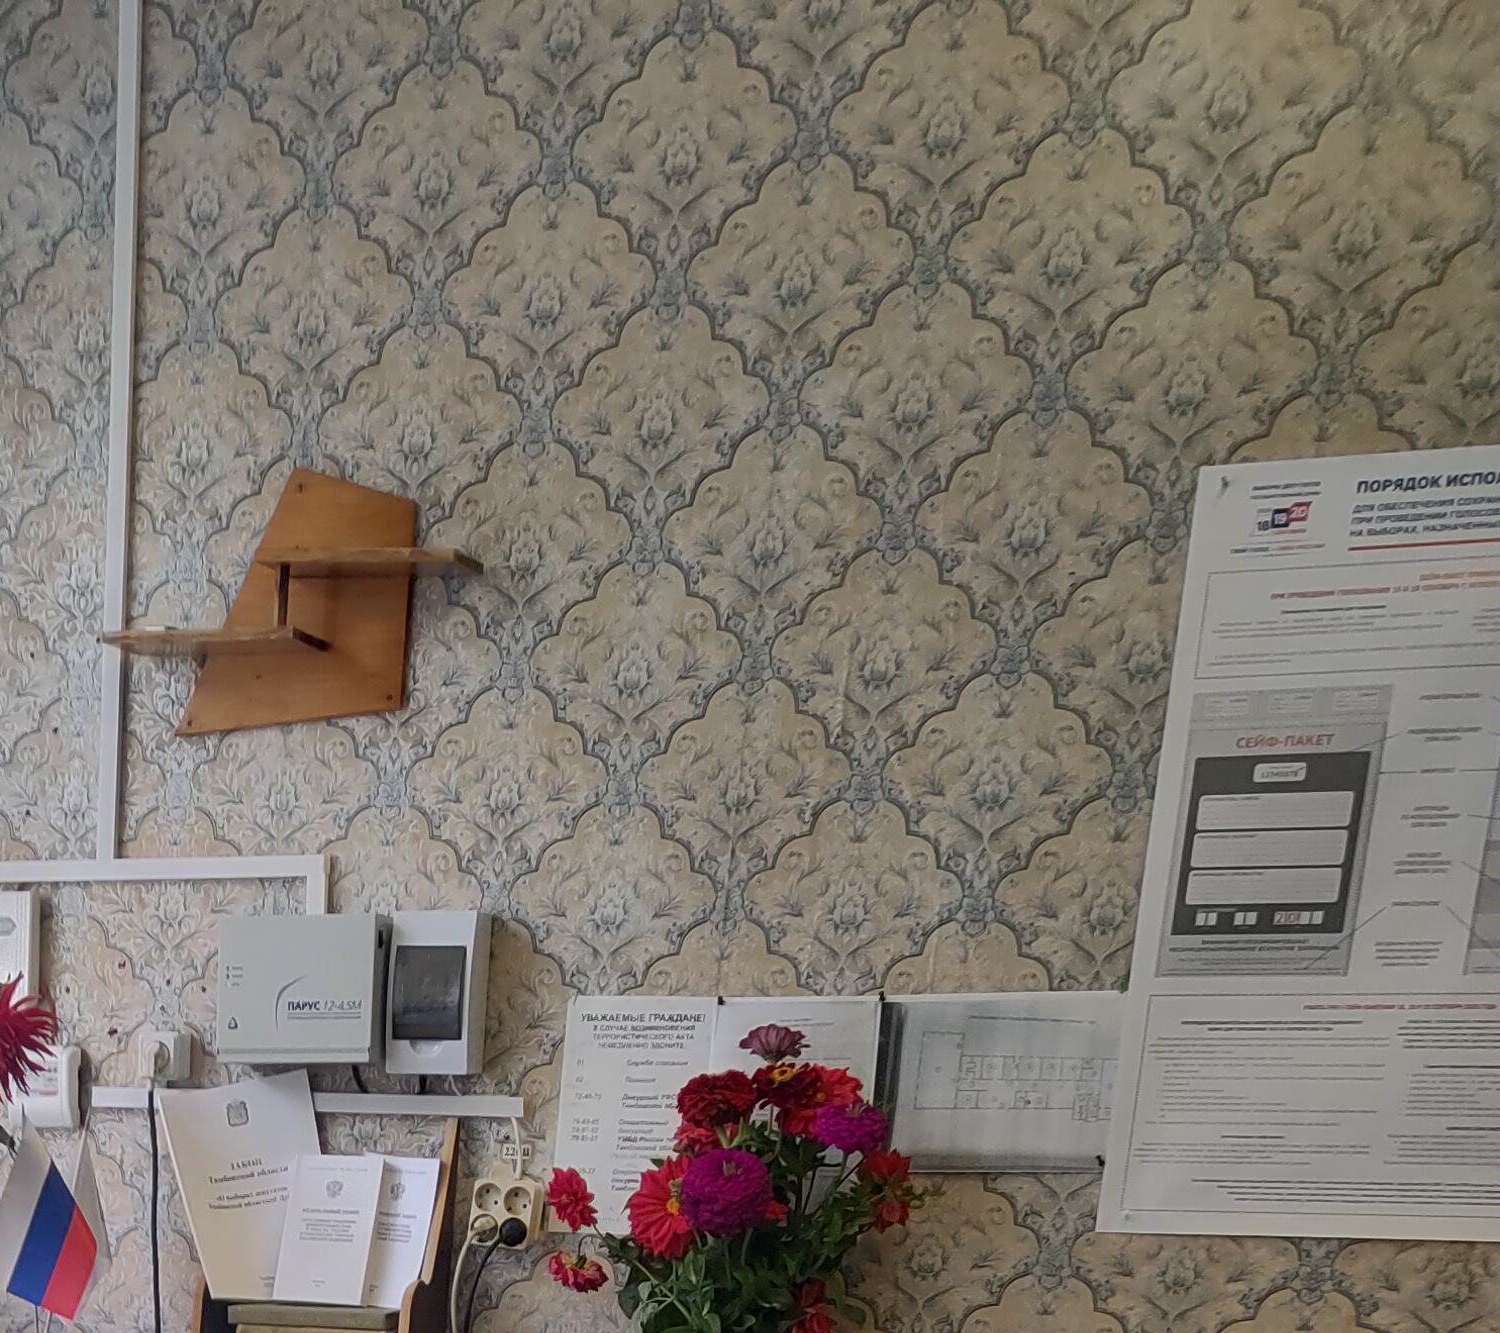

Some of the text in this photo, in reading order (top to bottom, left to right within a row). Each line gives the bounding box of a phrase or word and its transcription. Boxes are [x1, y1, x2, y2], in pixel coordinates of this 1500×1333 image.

[1356, 474, 1443, 494] ПОРЯДОК
[1236, 733, 1336, 749] СЕЙФ-ПАКЕТ
[287, 1000, 321, 1012] ПАРУС
[581, 1012, 706, 1024] УВАЖАЕМЫЕ ГРАЖДАНЕ!
[599, 1024, 629, 1032] СЛУЧАЕ
